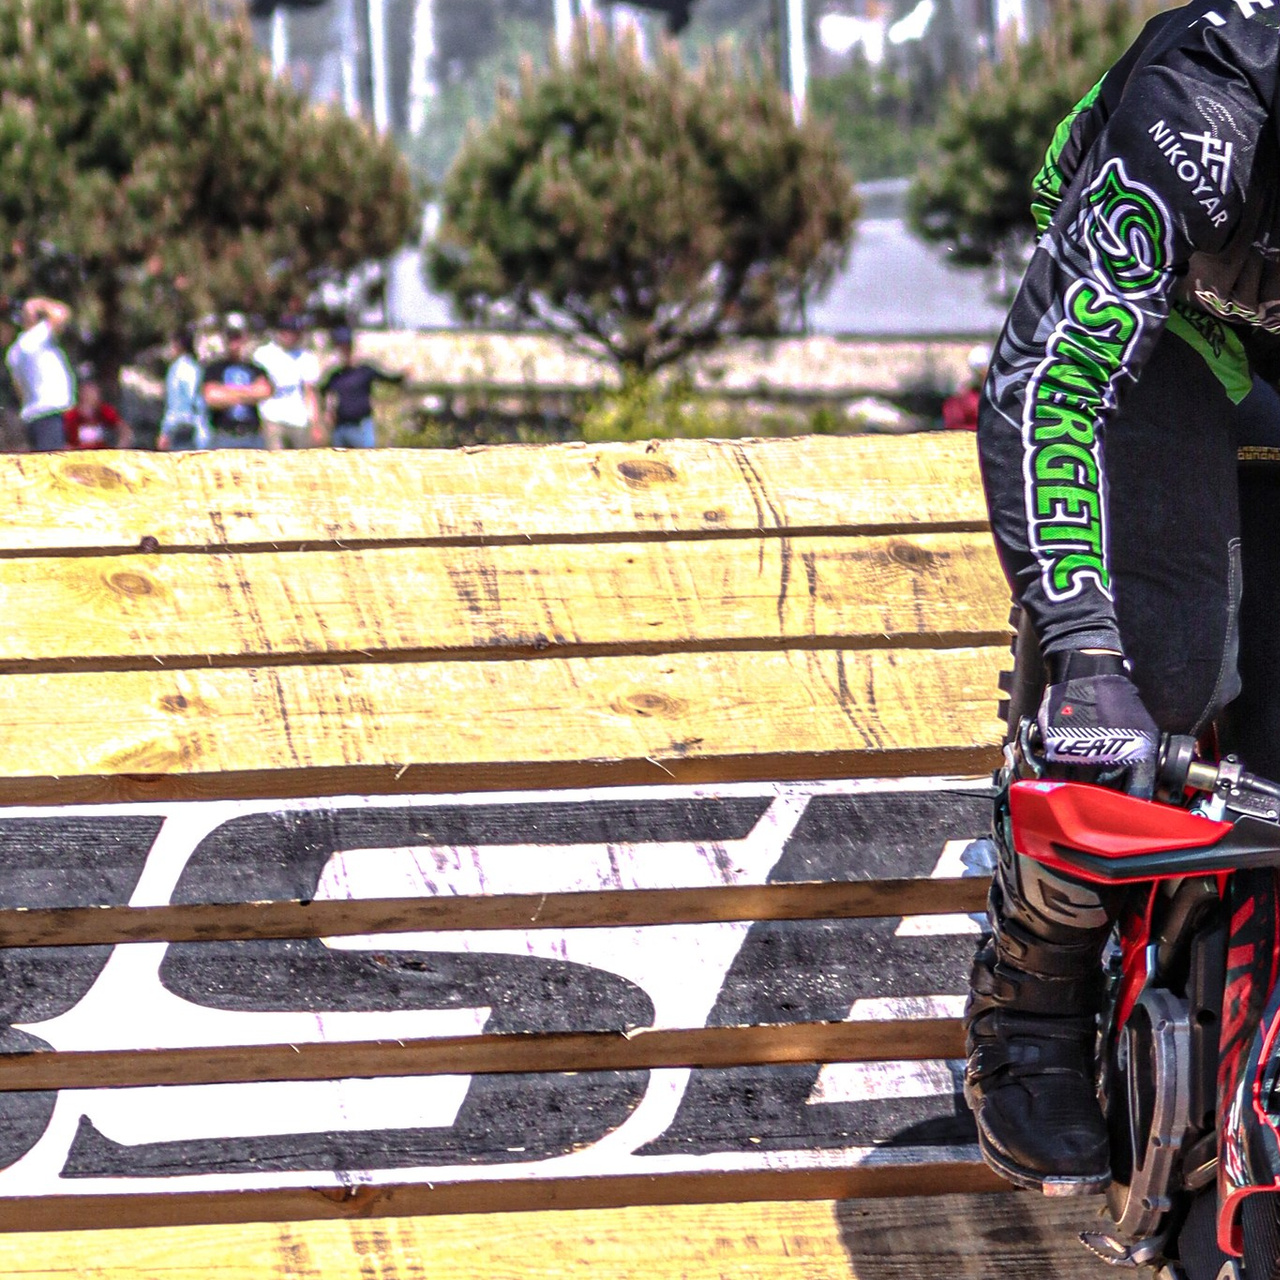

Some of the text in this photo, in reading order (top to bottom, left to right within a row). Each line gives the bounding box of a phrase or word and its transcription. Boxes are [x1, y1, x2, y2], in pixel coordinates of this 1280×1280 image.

[1148, 120, 1229, 228] NIKOYAR
[1028, 282, 1139, 596] SYNERGETC
[1053, 737, 1136, 757] LEATT
